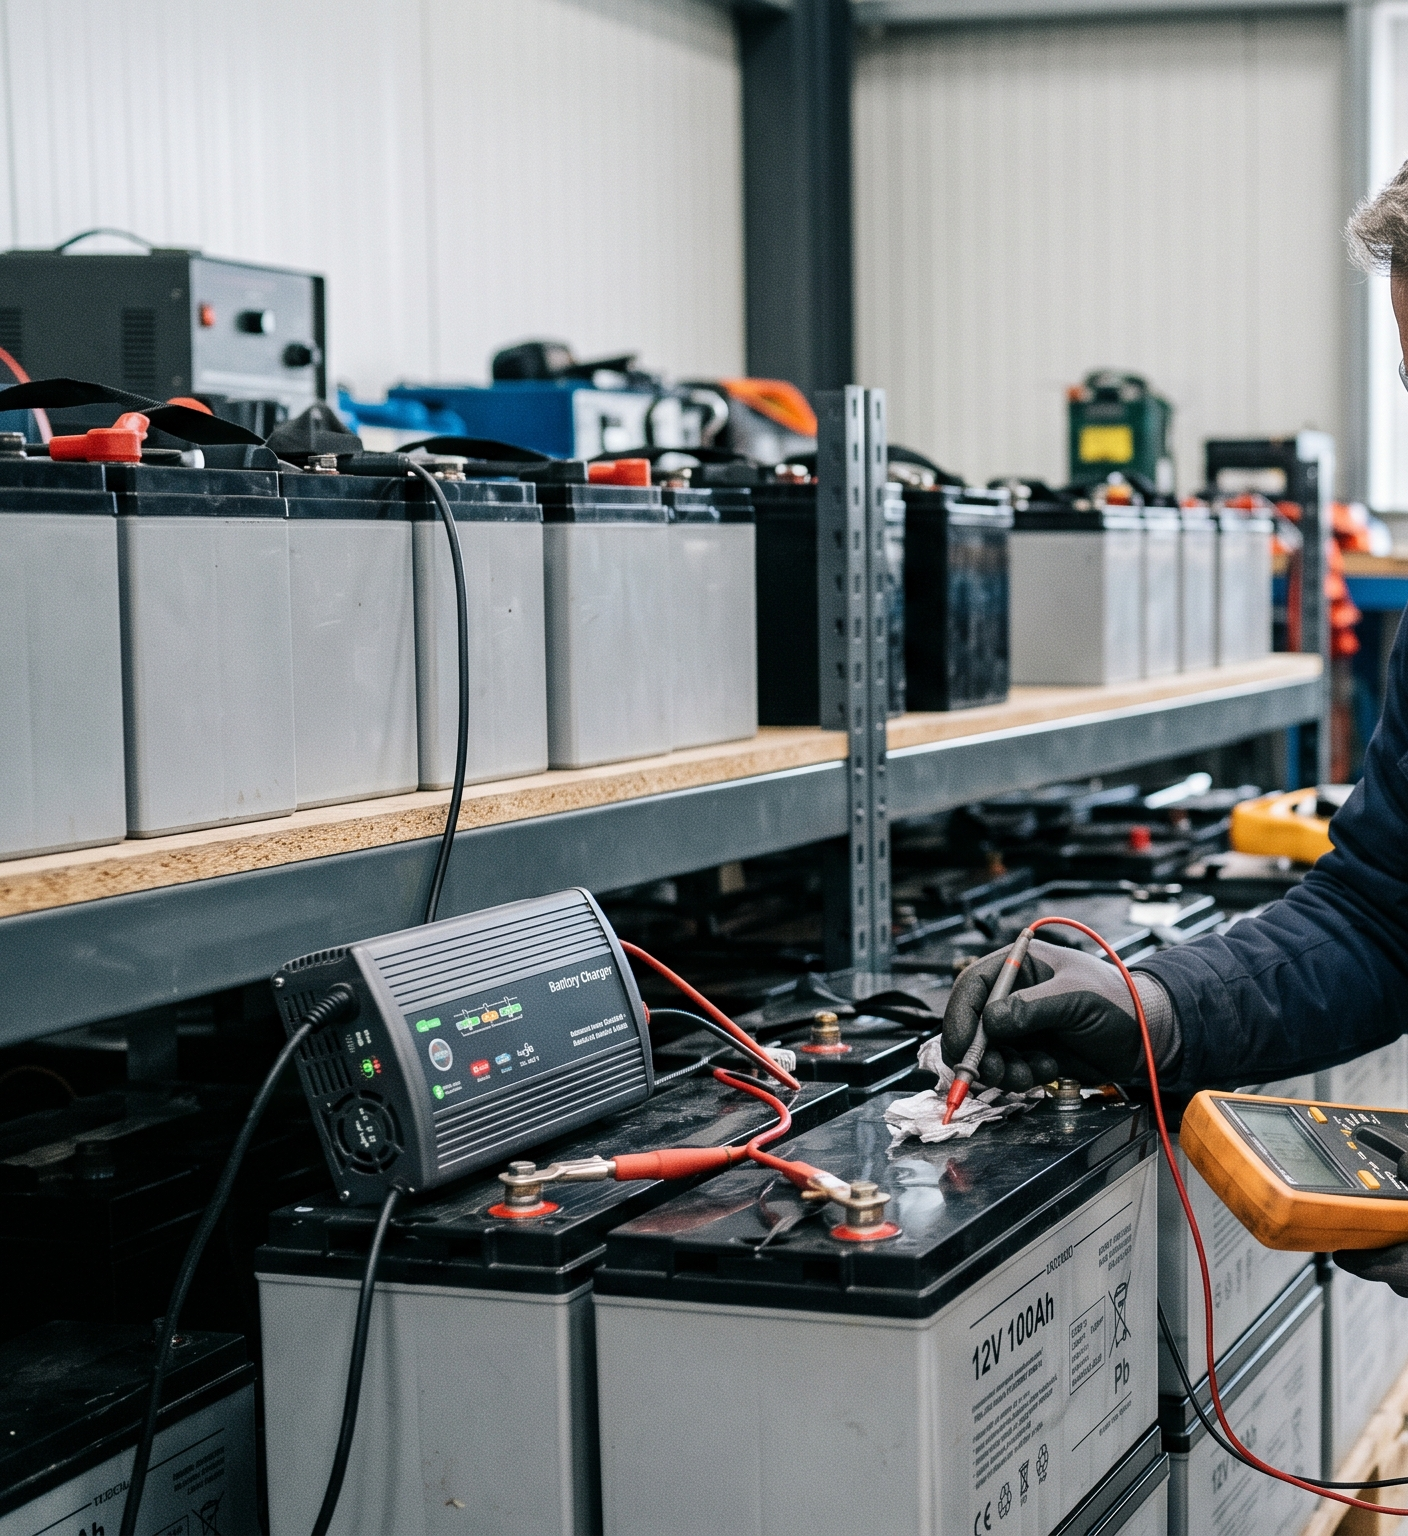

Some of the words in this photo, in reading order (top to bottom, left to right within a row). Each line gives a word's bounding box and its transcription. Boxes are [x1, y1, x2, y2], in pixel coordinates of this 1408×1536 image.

[580, 965, 612, 983] Charger
[972, 1328, 1003, 1381] 12V
[1007, 1292, 1054, 1352] 100Ah
[1114, 1357, 1130, 1394] Pb
